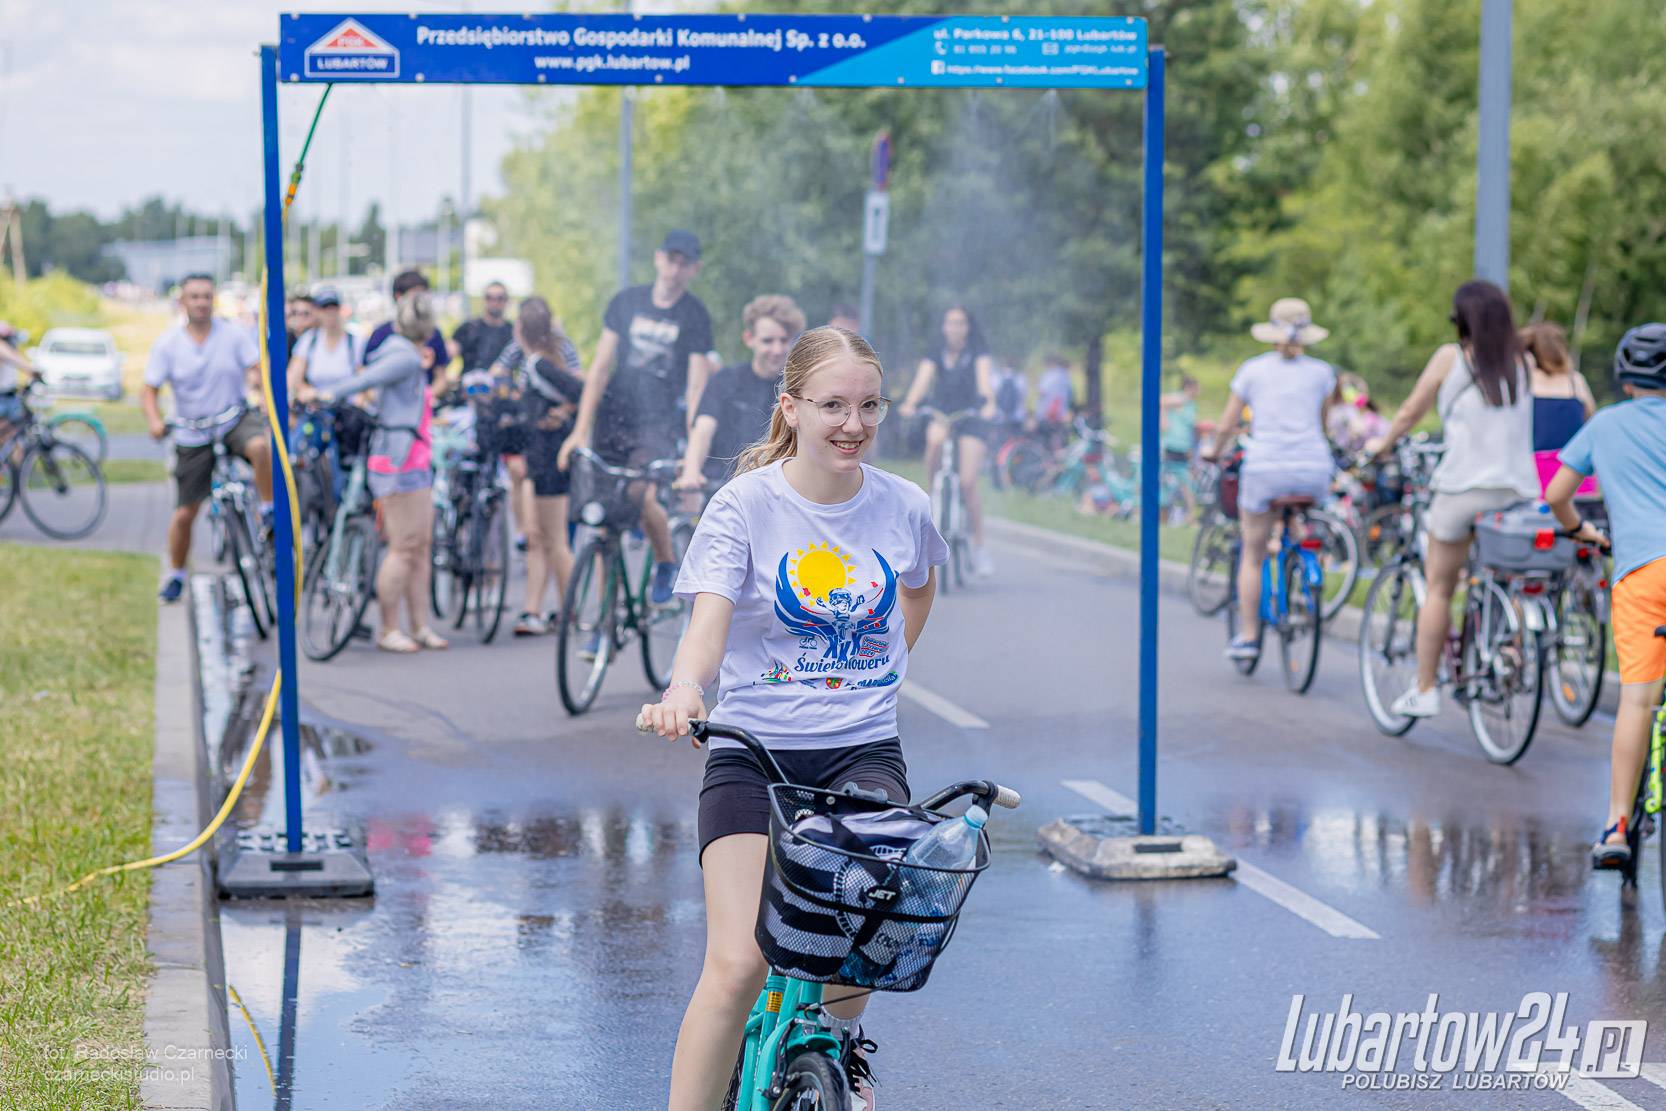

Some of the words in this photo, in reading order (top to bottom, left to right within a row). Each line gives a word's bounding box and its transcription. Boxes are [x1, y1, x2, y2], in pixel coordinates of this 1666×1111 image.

[417, 26, 570, 49] Przedsiębiorstwo
[573, 27, 673, 50] Gospodarki
[677, 28, 782, 52] Komunalnej
[786, 29, 814, 52] Sp.
[818, 33, 829, 48] z
[832, 33, 866, 48] o.o.
[868, 889, 897, 901] JET
